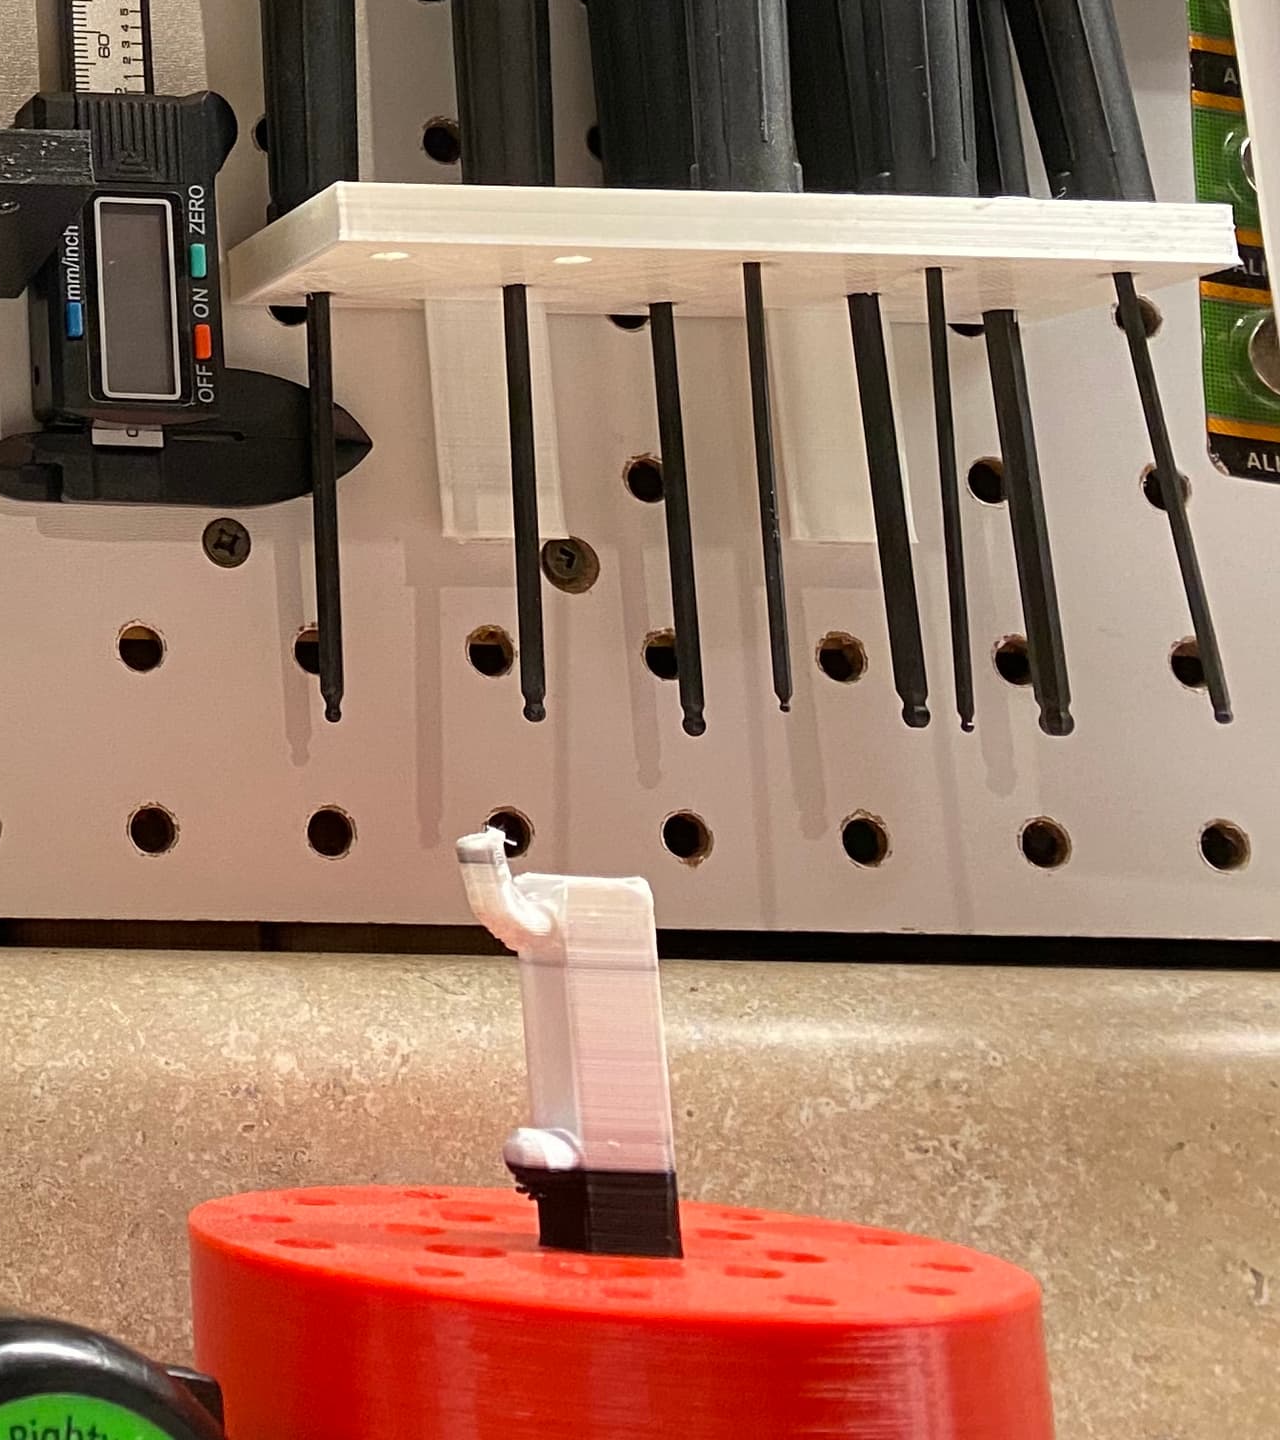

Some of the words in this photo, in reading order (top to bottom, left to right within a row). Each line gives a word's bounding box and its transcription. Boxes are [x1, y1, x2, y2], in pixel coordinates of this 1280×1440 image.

[98, 33, 111, 58] 60
[188, 184, 206, 236] ZERO
[61, 224, 81, 301] mm/inch
[193, 287, 209, 319] ON
[196, 364, 215, 404] OFF
